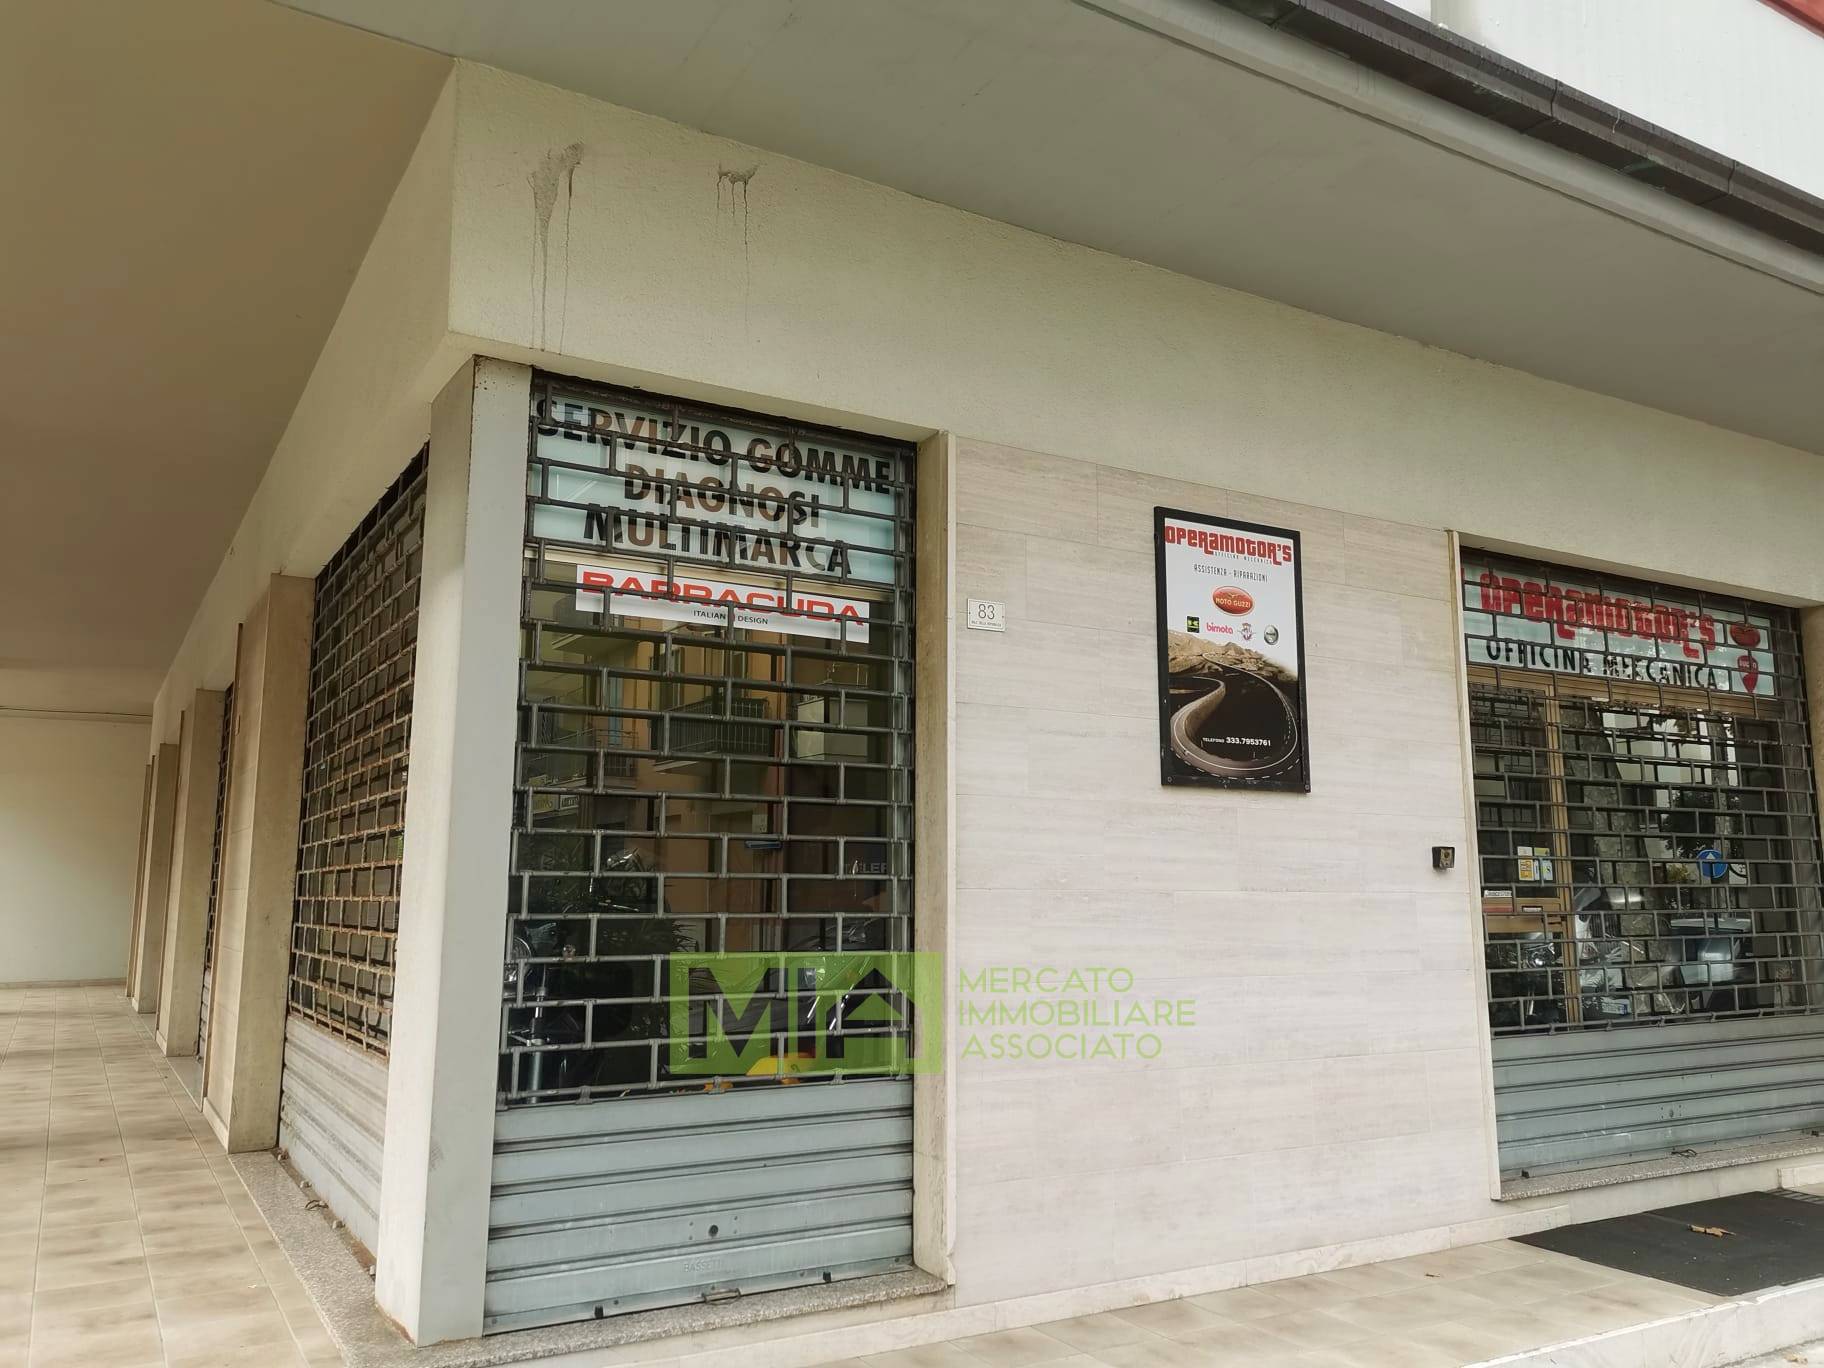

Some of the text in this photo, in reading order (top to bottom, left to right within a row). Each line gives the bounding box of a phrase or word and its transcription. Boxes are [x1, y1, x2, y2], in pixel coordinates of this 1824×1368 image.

[537, 399, 890, 494] SERVIZIO GOMME
[625, 463, 819, 528] DIAGNOSI
[583, 503, 852, 574] MULTIMARCA
[1194, 563, 1227, 577] ASSISTENZA
[1233, 569, 1268, 583] RIPARAZIONI
[582, 571, 864, 626] BARRACUDA
[1215, 597, 1251, 608] MOTO GUZZI
[693, 609, 768, 625] ITALIAN DESIGN
[978, 603, 995, 620] 83
[1206, 622, 1234, 635] bimota
[1226, 736, 1271, 747] 333.7953761
